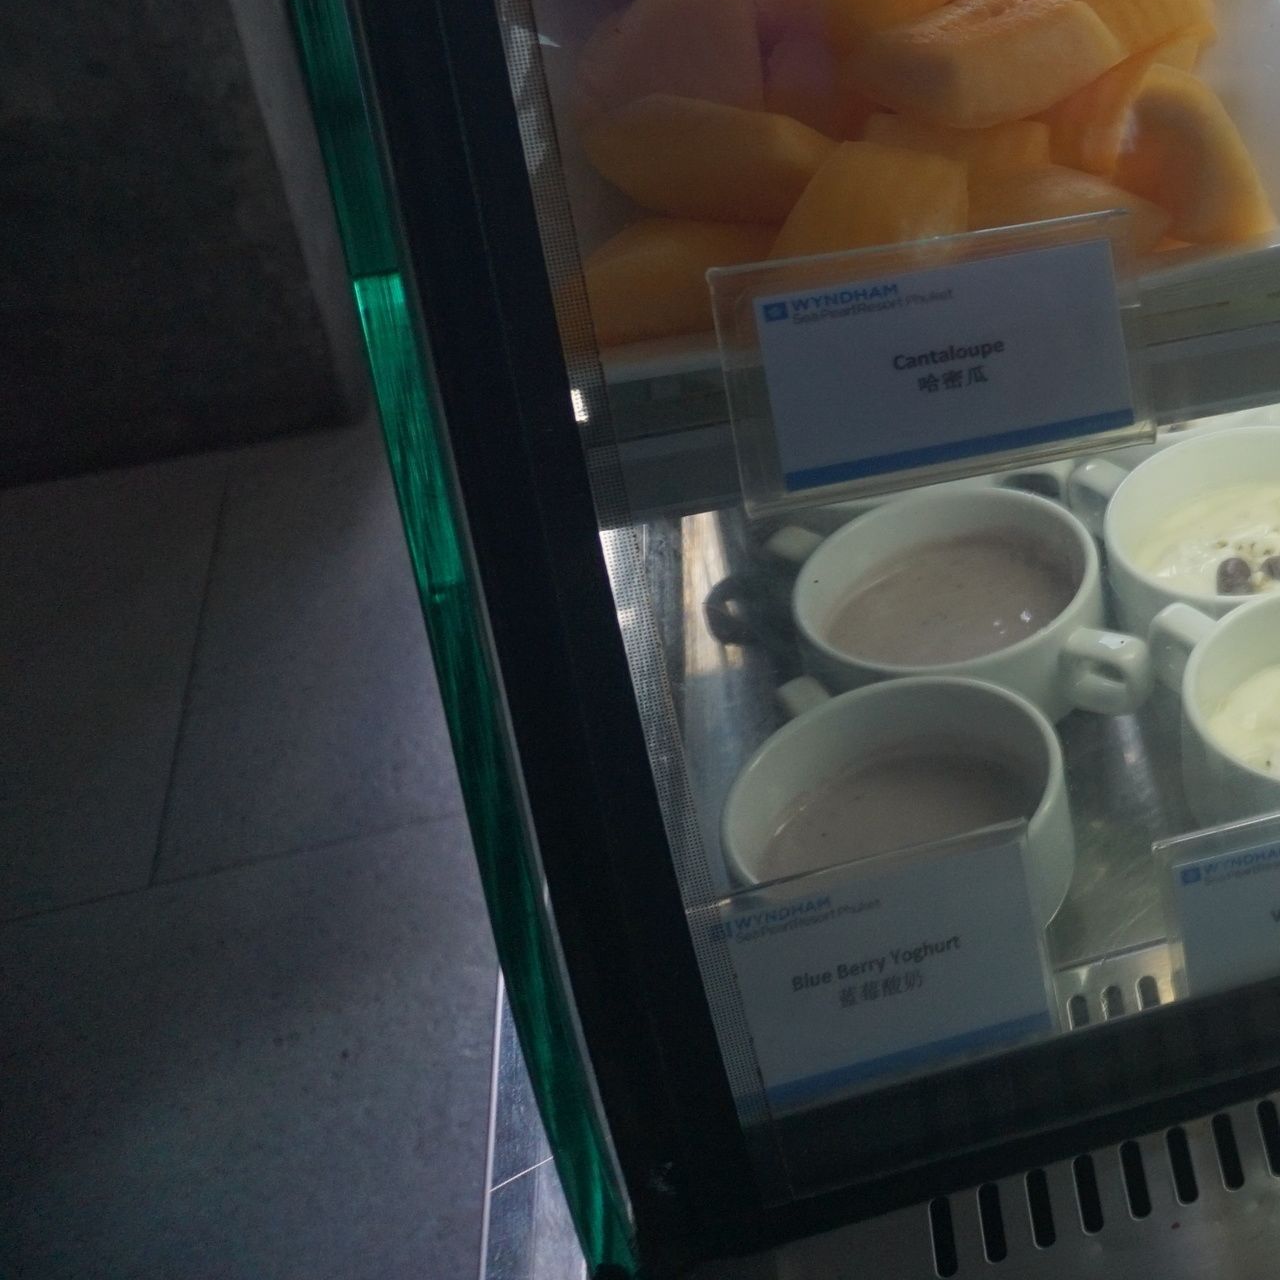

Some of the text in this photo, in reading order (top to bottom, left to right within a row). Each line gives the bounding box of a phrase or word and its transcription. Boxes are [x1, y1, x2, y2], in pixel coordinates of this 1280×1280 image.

[792, 283, 899, 312] WYNDHAM
[892, 340, 1005, 371] Cantaloupe
[917, 365, 989, 393] 哈密瓜
[735, 896, 831, 929] WYNDHAM
[792, 935, 961, 992] Blue Berry Yoghurt
[840, 970, 924, 1009] 蓝莓酸奶
